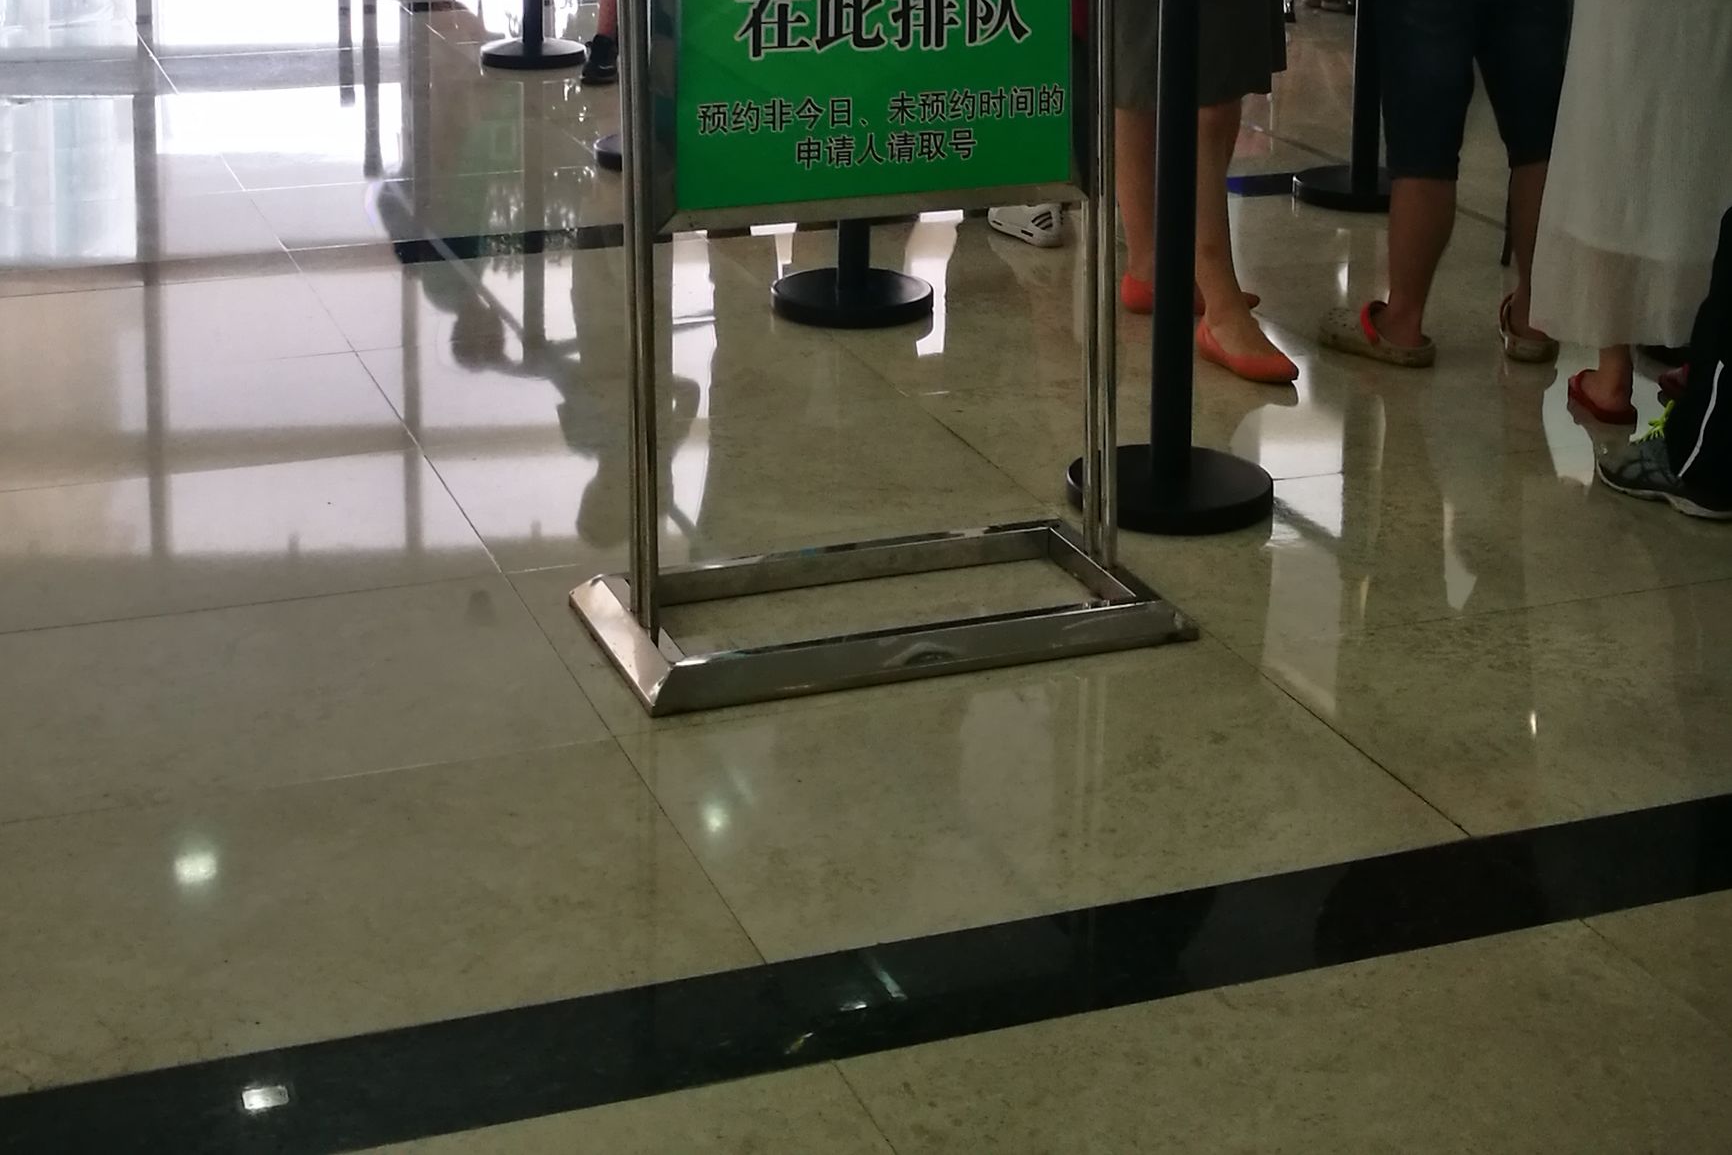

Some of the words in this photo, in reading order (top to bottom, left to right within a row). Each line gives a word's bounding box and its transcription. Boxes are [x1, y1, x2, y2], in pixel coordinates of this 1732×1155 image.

[696, 83, 1065, 136] 预约非今日、未预约时间的
[794, 131, 978, 170] 申请人请取号
